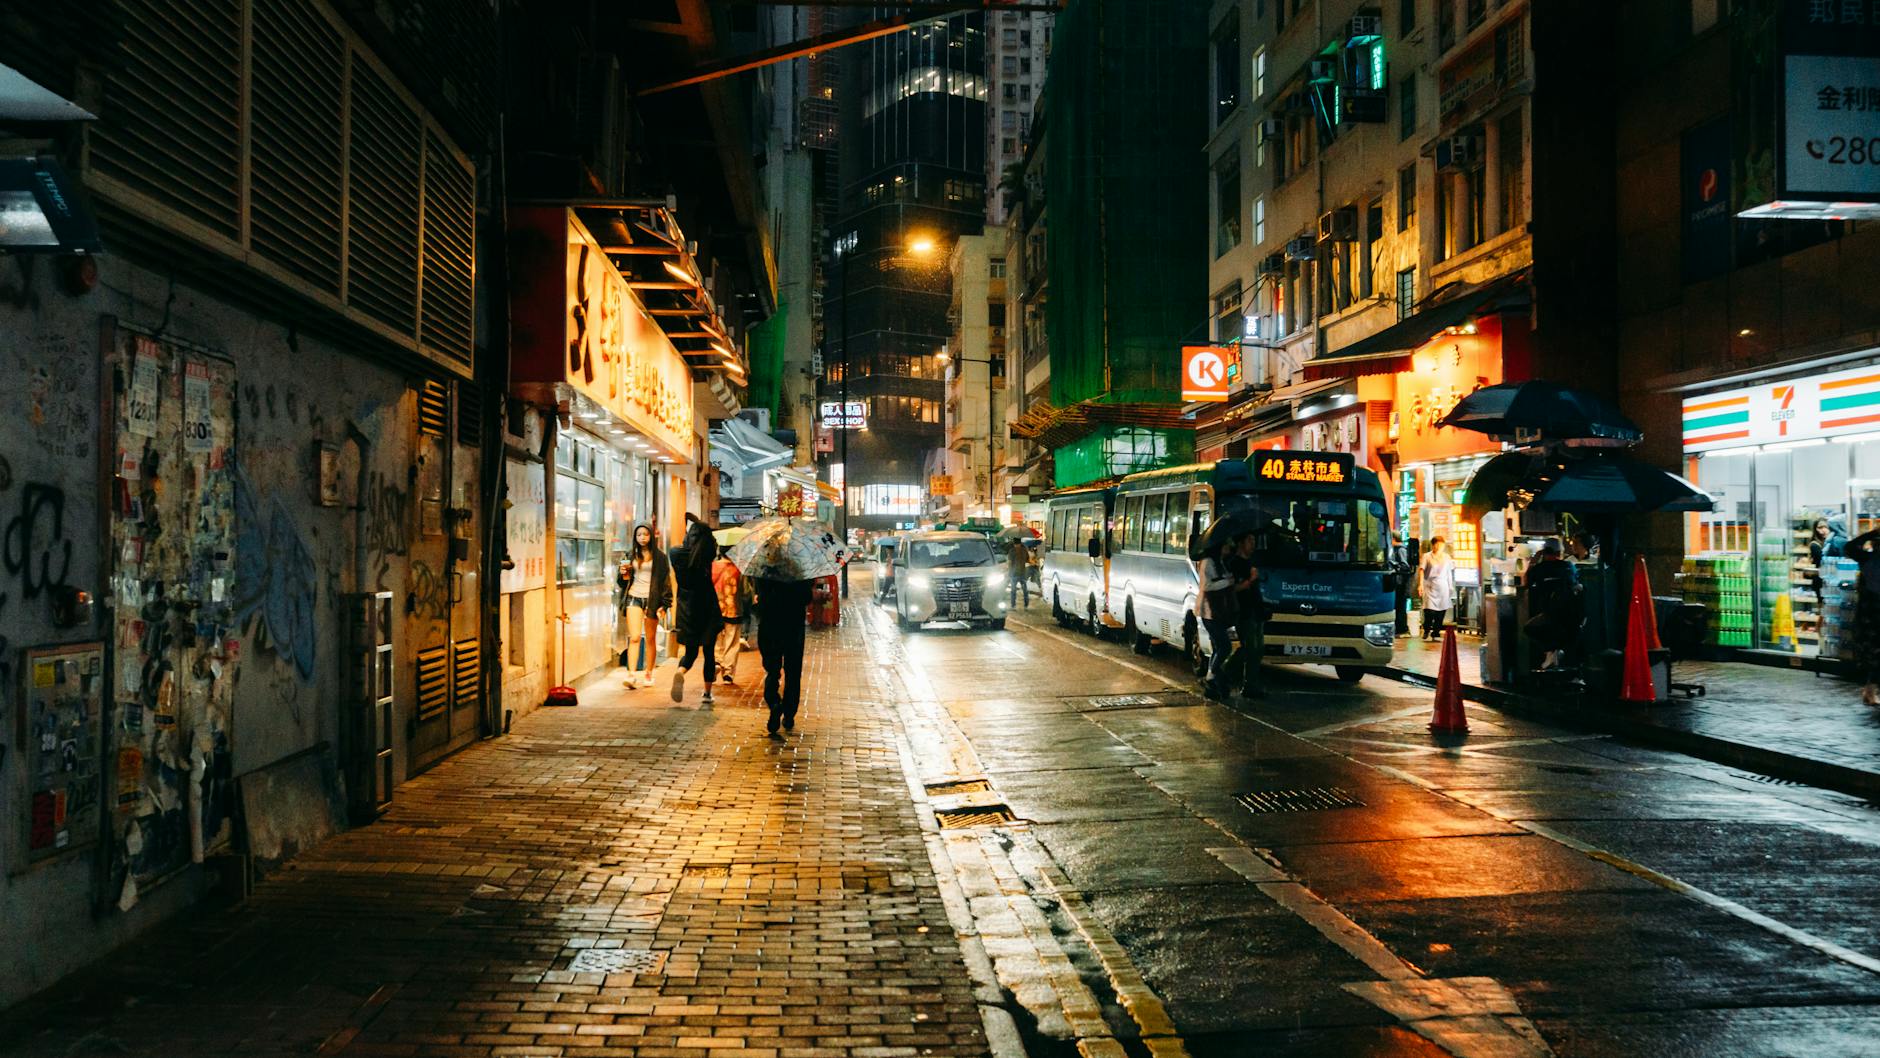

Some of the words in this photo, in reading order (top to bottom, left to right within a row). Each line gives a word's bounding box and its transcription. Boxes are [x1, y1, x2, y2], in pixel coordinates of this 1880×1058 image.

[1772, 385, 1795, 436] 7
[823, 417, 840, 425] SEX
[1261, 458, 1285, 479] 40
[1289, 459, 1341, 474] 赤柱市集
[1286, 472, 1316, 481] STANLEY
[1316, 473, 1344, 482] MARKET
[1281, 581, 1310, 593] Expert
[1312, 583, 1333, 592] Care
[1290, 646, 1303, 654] XY
